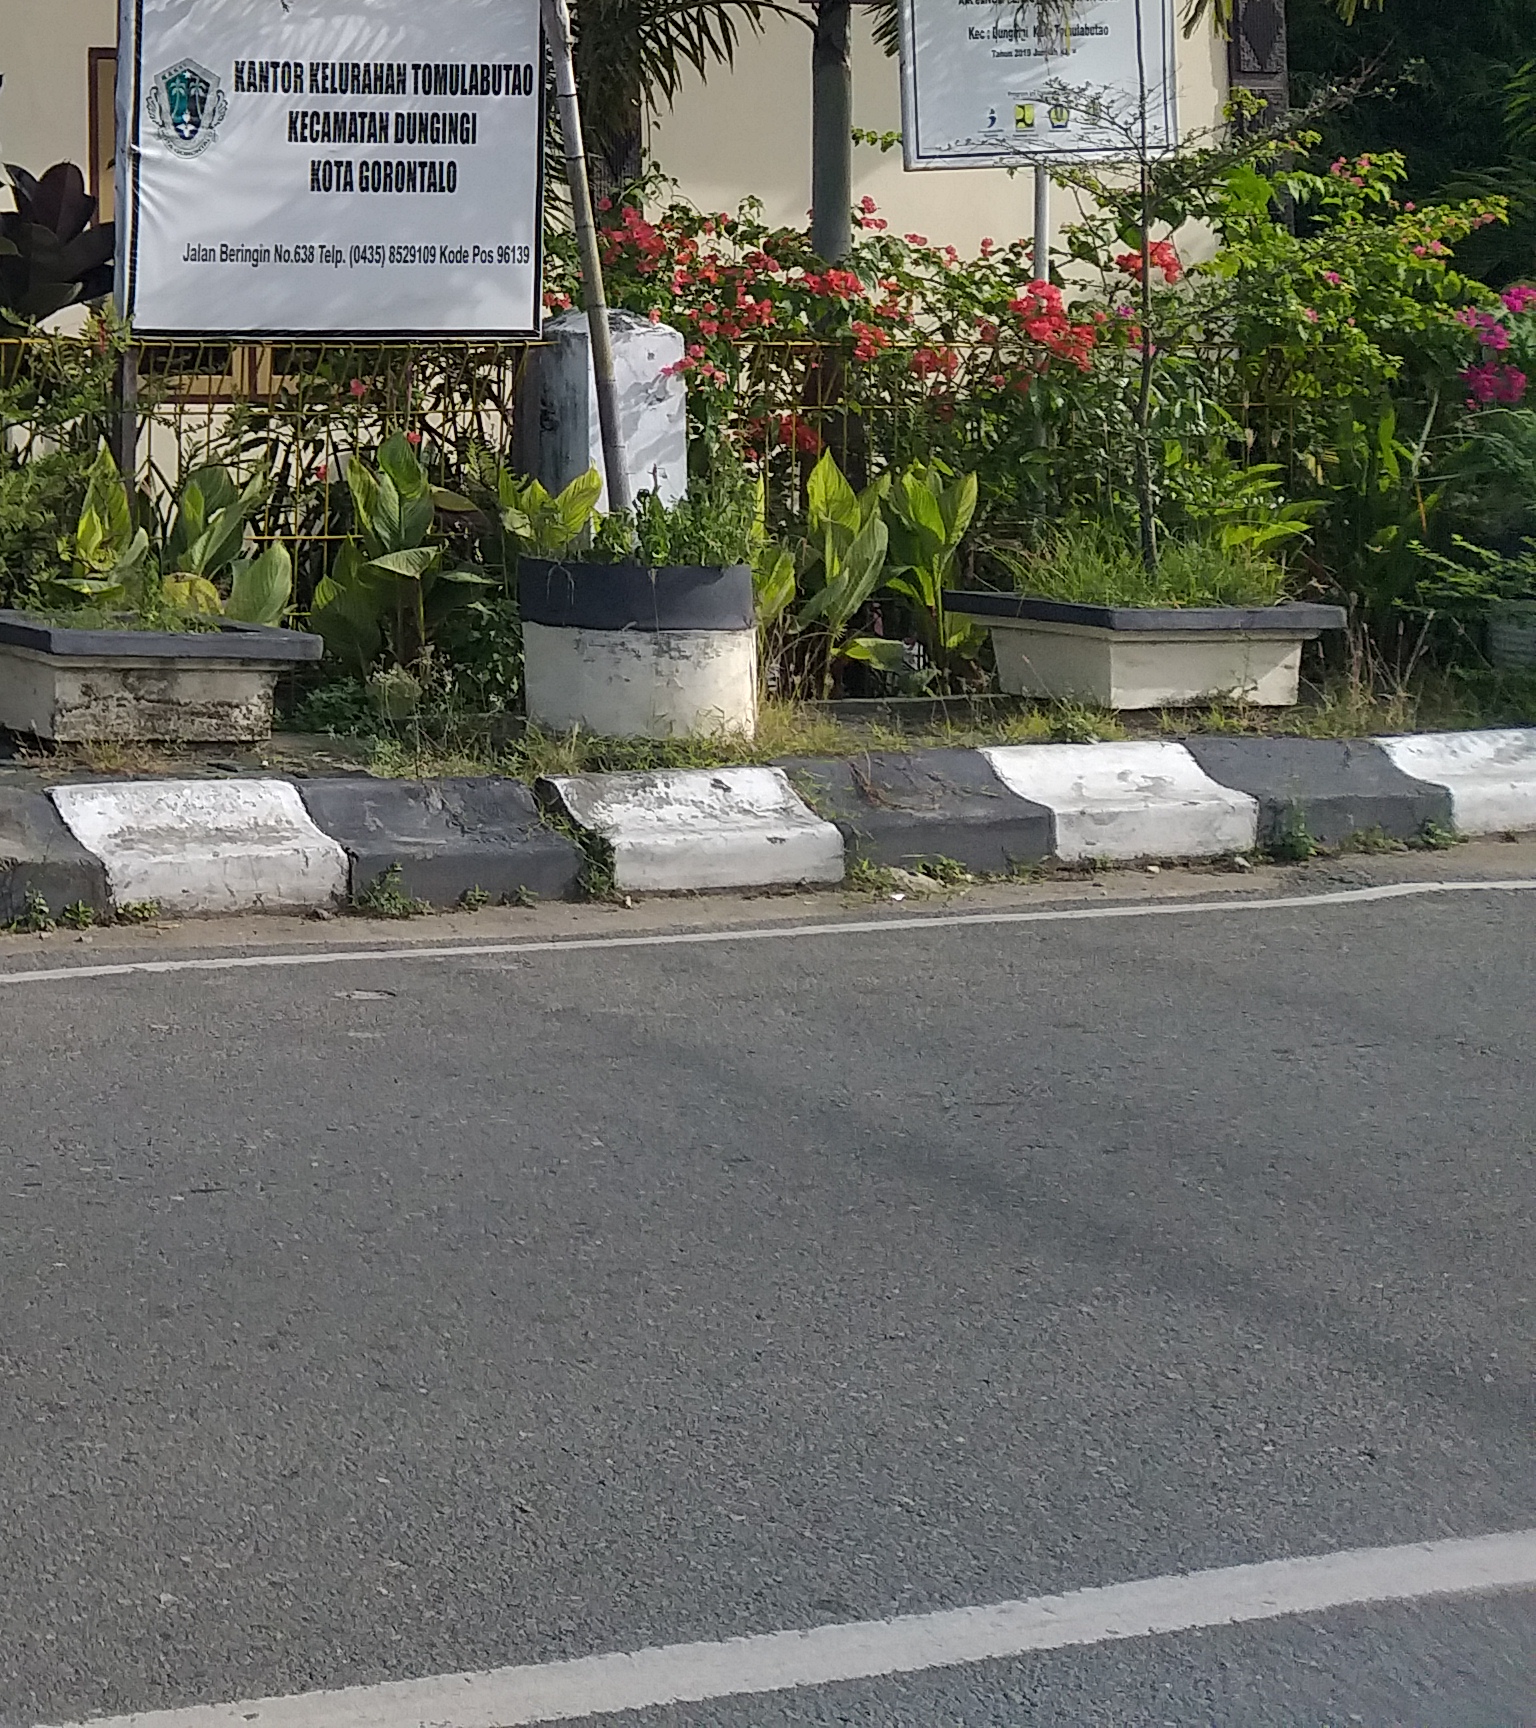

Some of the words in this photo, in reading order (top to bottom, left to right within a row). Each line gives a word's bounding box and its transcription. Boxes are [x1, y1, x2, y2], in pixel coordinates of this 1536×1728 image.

[234, 60, 304, 94] KANTOR
[309, 61, 407, 95] KELURAHAN
[411, 63, 534, 97] TOMULABUTAO
[287, 110, 389, 144] KECAMATAN
[394, 112, 477, 145] DUNGINGI
[310, 159, 354, 193] KOTA
[359, 159, 458, 193] GORONTALO
[182, 242, 216, 263] Jalan
[219, 243, 271, 268] Beringin
[273, 243, 315, 264] No.638
[318, 244, 346, 269] Telp.
[349, 244, 386, 269] (0435)
[388, 244, 436, 265] 8529109
[439, 244, 470, 265] Kode
[472, 245, 494, 265] Pos
[496, 245, 530, 265] 96139
